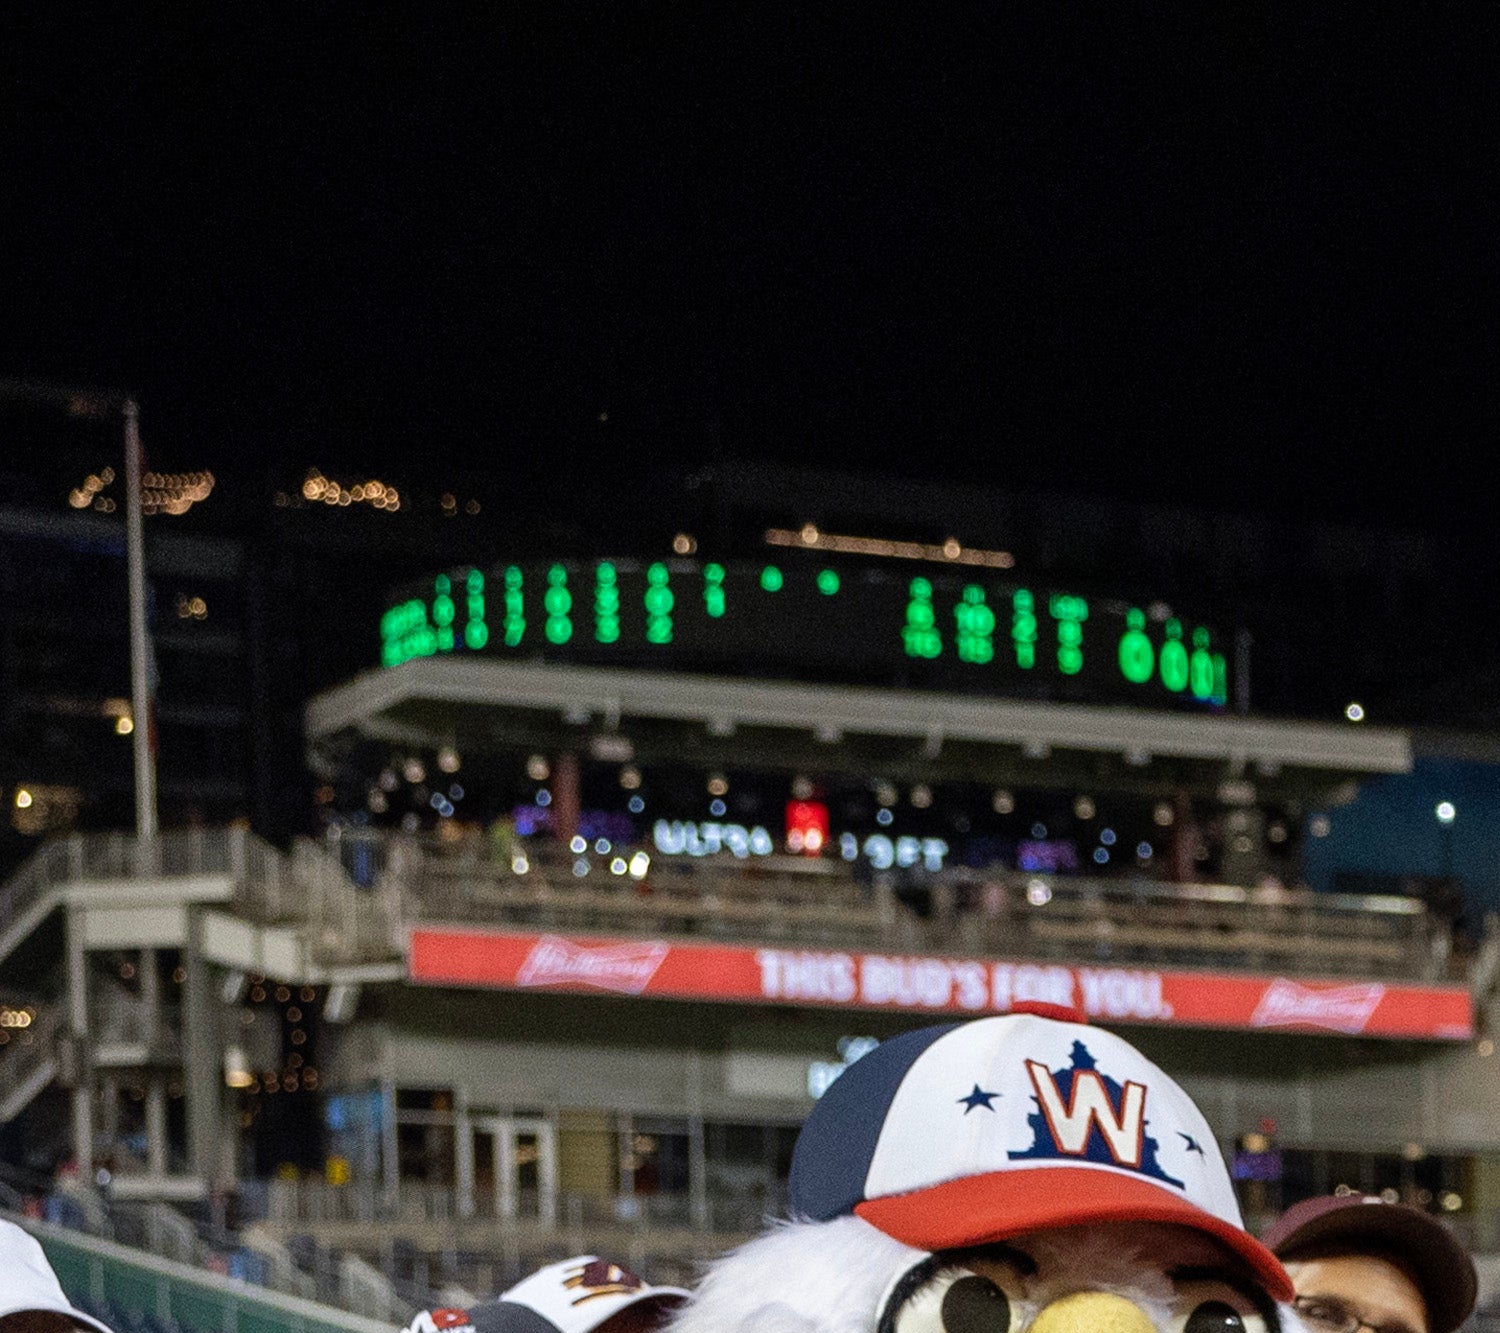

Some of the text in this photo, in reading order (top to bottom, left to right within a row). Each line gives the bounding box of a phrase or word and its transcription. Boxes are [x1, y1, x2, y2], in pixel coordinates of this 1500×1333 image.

[757, 948, 1174, 1020] THIS BUD'S FOR YOU.
[1024, 1058, 1148, 1169] W
